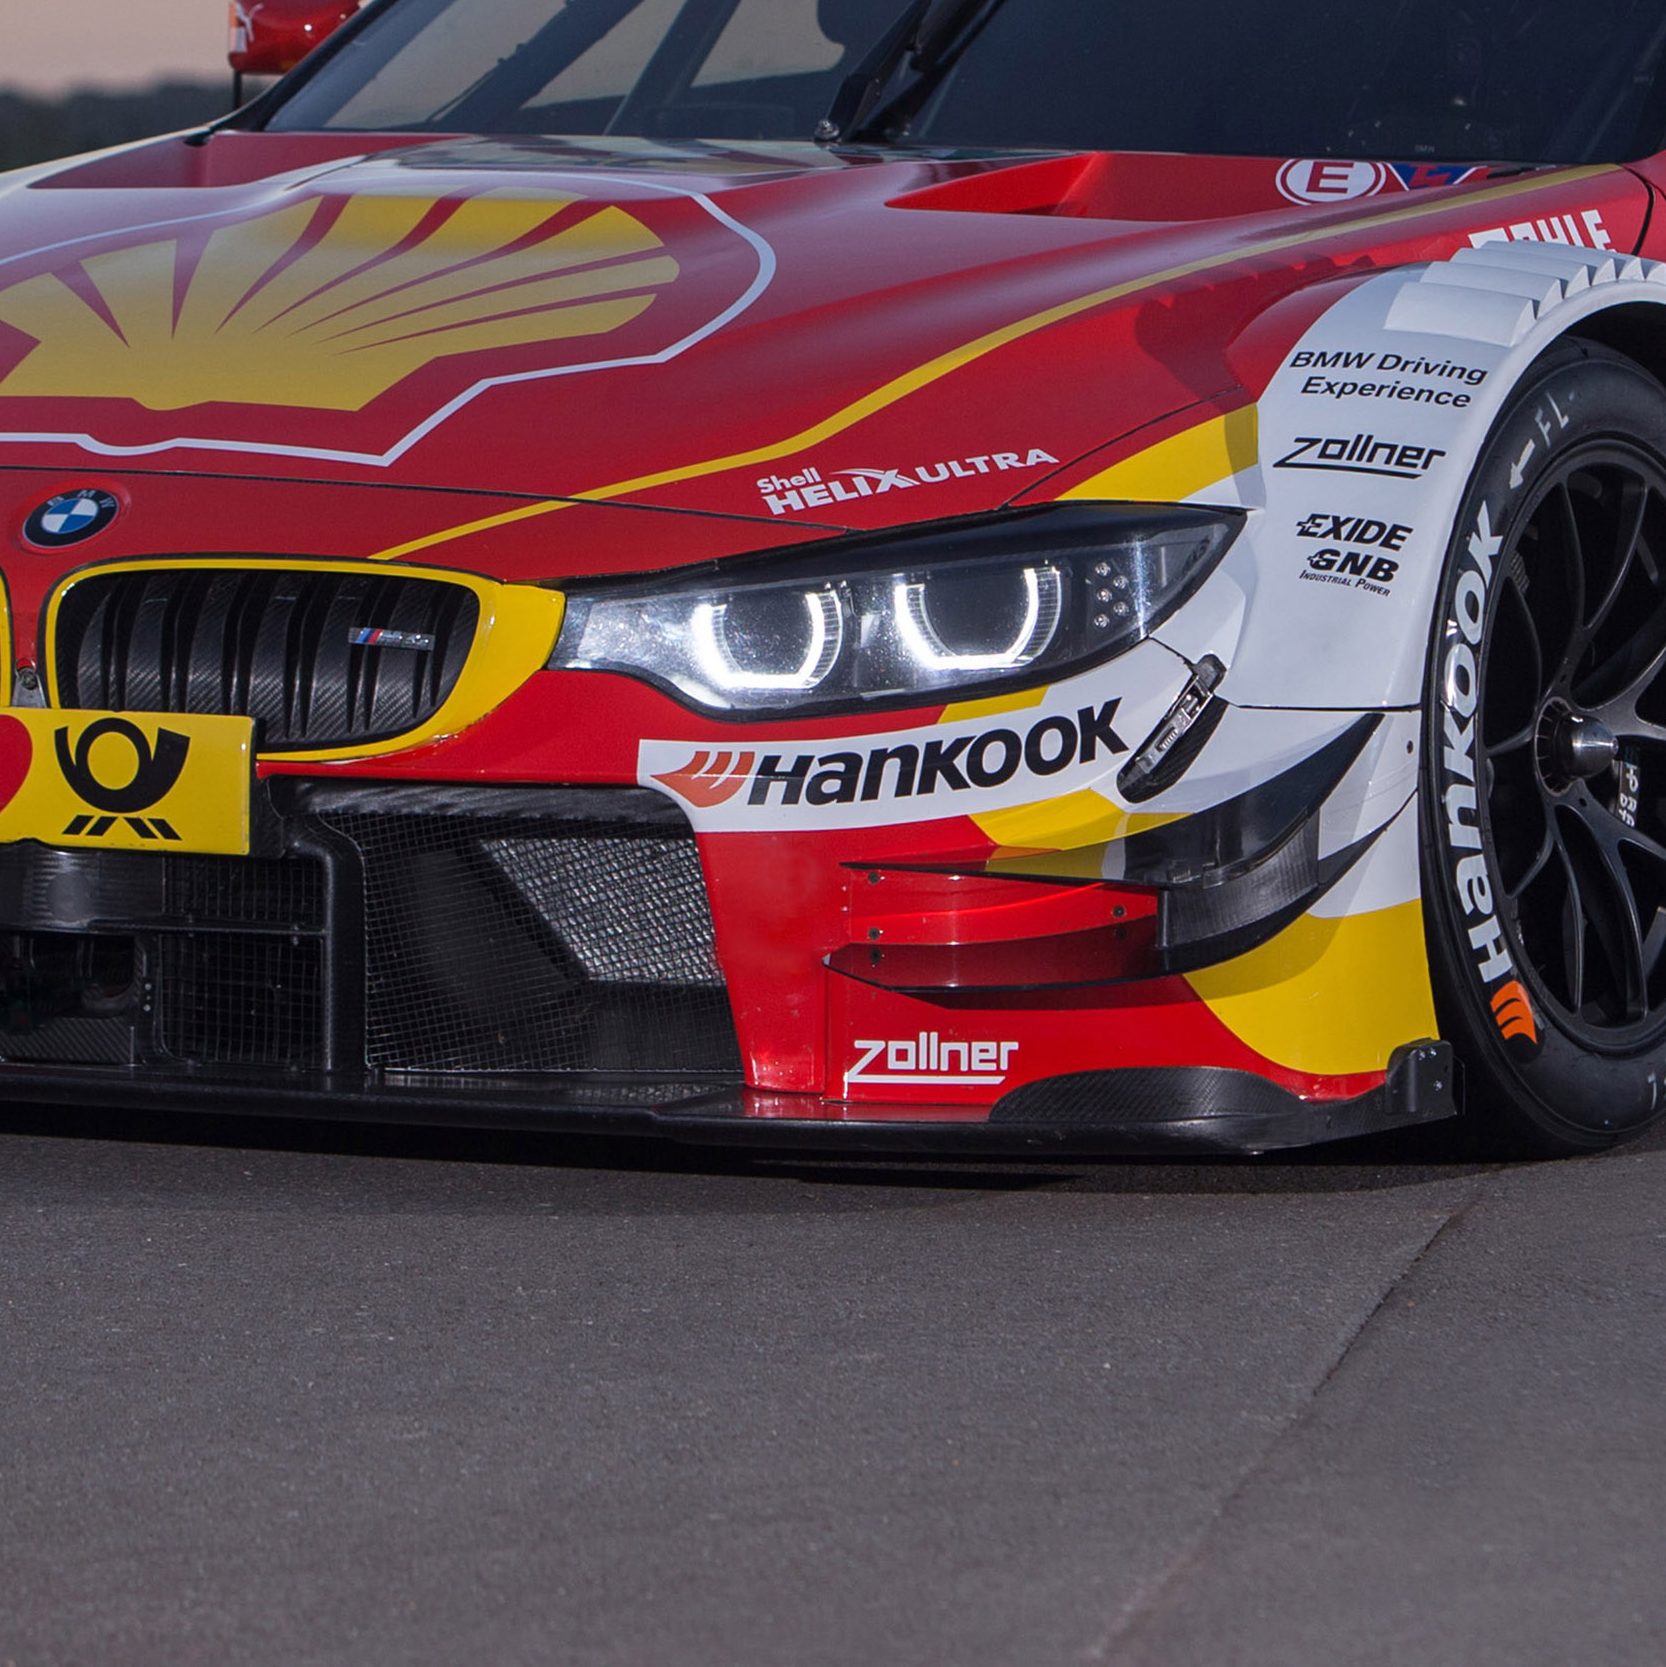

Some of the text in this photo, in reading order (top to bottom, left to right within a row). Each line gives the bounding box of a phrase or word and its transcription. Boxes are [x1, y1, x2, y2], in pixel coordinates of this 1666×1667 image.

[1304, 160, 1355, 194] E
[1290, 351, 1488, 386] BMW Driving
[1300, 376, 1472, 409] Experience
[756, 466, 821, 494] Shell
[761, 448, 1060, 515] HELIX ULTRA
[47, 489, 116, 508] BMW
[1295, 512, 1415, 552] EXIDE
[1306, 548, 1399, 583] GNB
